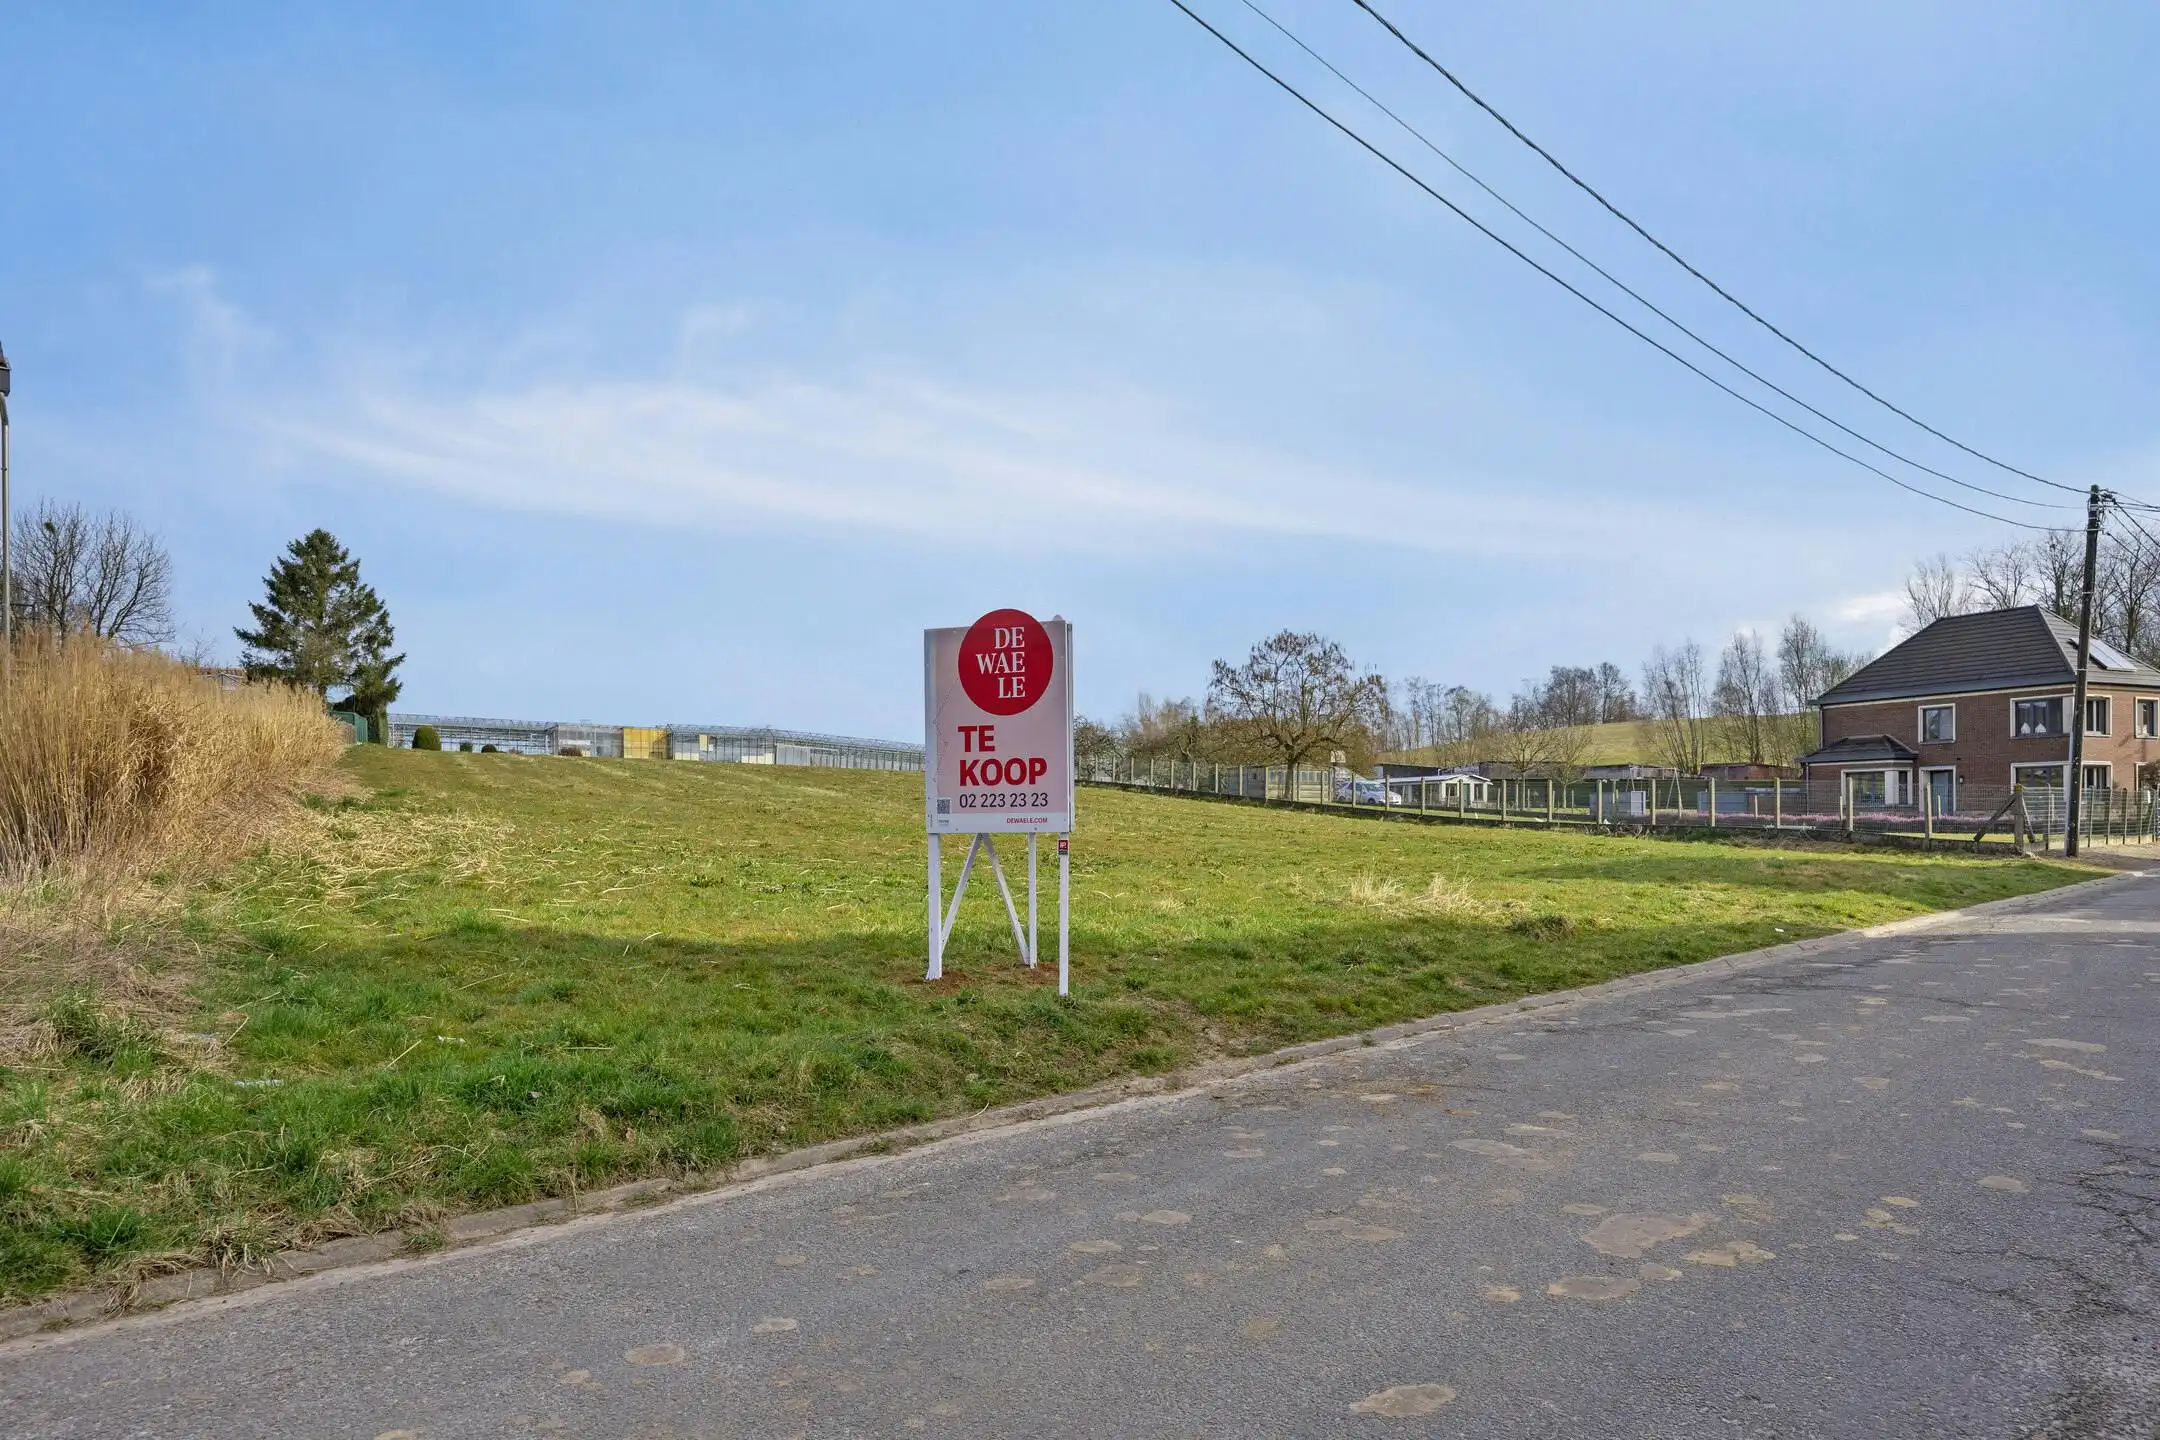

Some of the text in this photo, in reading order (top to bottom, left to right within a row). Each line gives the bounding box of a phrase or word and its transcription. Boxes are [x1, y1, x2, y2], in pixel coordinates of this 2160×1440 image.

[995, 627, 1025, 649] DE
[976, 652, 1025, 674] WAE
[998, 677, 1026, 698] LE
[958, 725, 995, 753] TE
[960, 757, 1047, 786] KOOP
[960, 792, 1048, 808] 02 223 23 23
